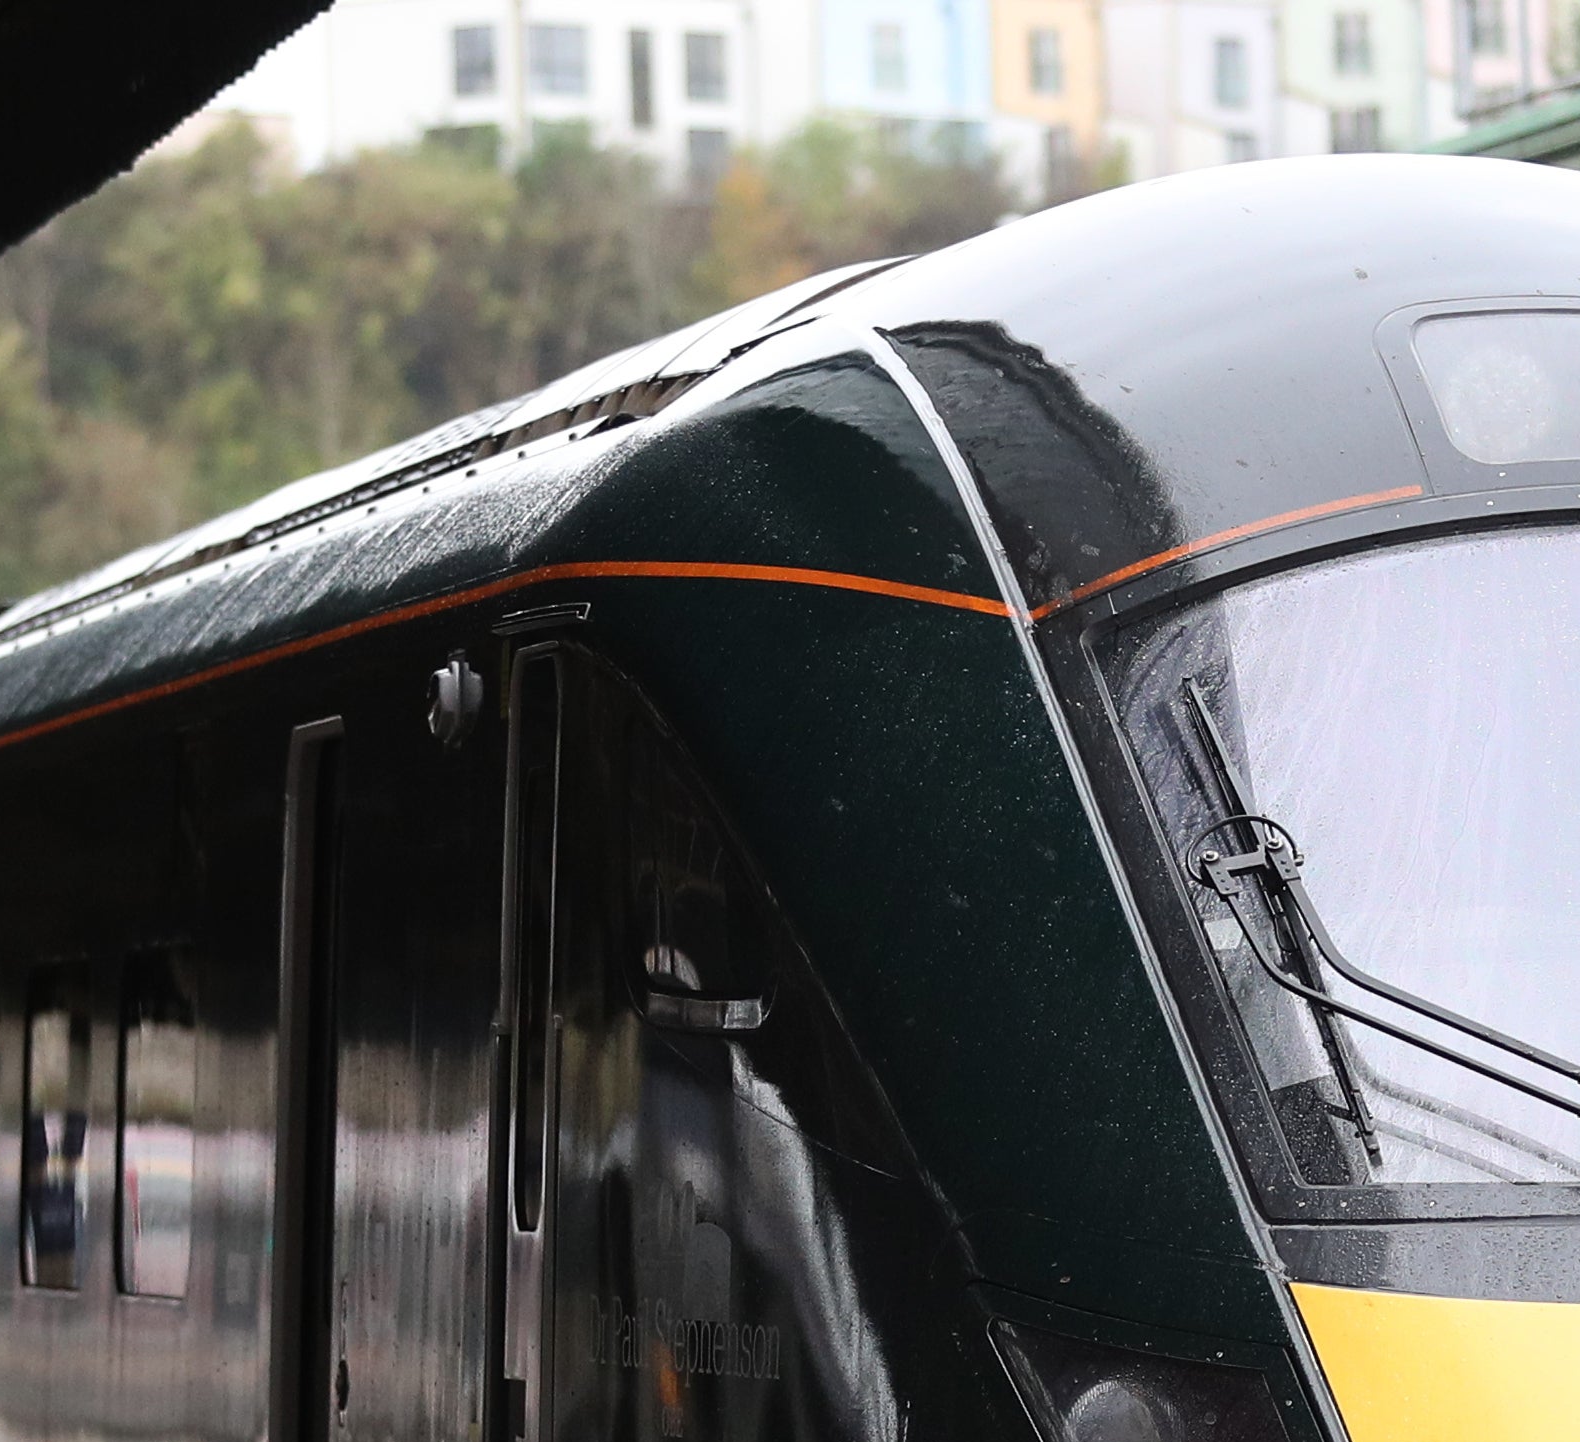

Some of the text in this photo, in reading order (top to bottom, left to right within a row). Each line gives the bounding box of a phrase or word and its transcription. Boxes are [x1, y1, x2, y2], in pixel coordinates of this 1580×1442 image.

[589, 1294, 781, 1388] Dr Paul Stephenson
